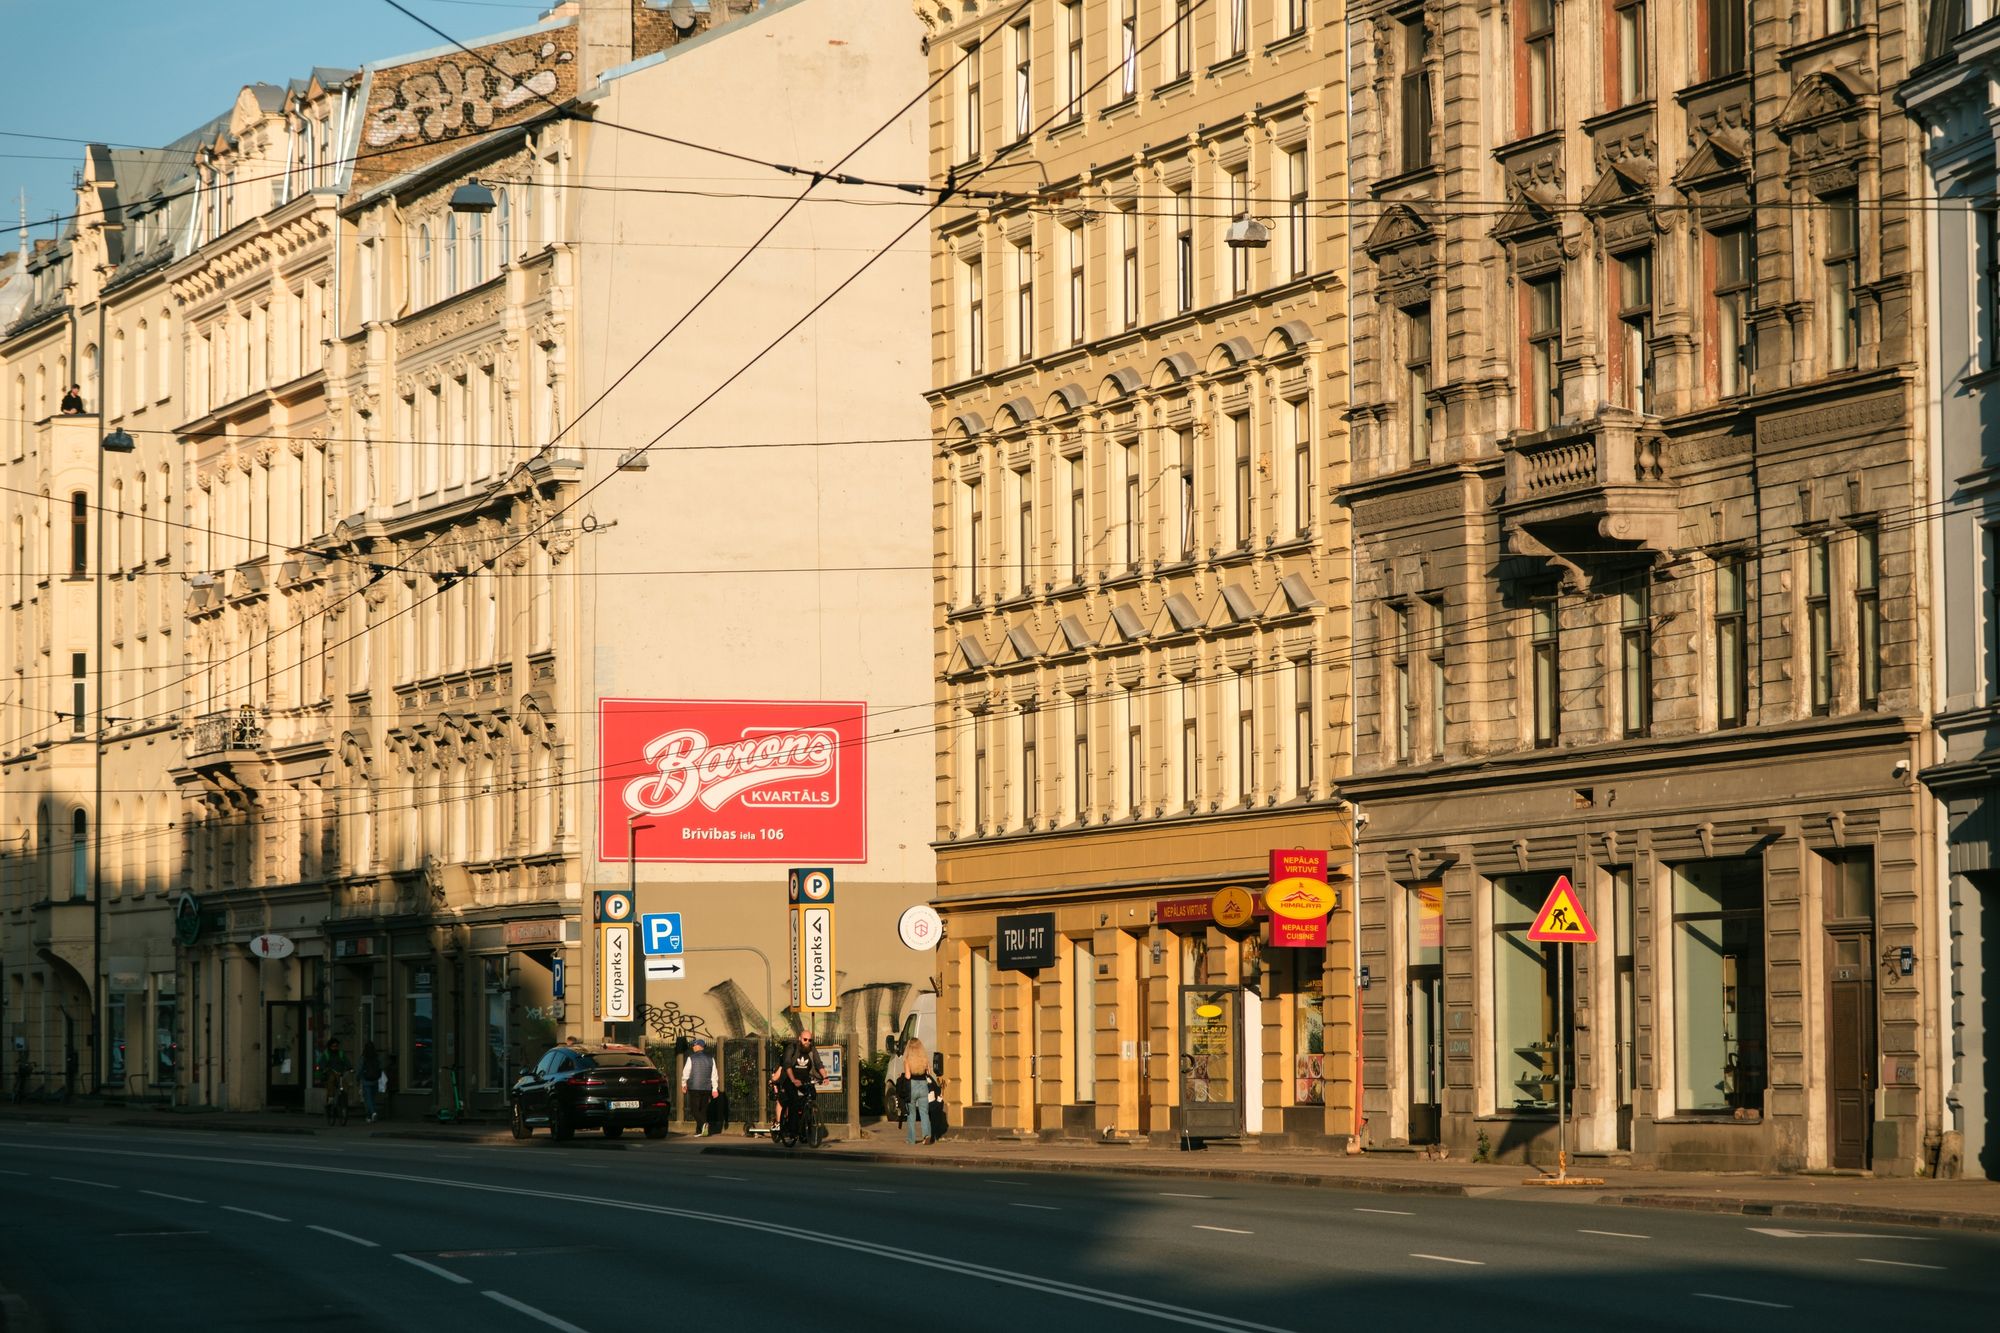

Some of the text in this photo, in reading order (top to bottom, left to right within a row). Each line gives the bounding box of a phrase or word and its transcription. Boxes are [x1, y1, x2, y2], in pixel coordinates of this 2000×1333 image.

[751, 789, 830, 803] KVARTĀLS
[682, 827, 784, 841] Brīvības iela 106
[1283, 855, 1319, 865] NEPĀLAS
[1285, 865, 1318, 874] VIRTUVE
[812, 879, 823, 893] P
[614, 900, 623, 914] P
[1163, 903, 1208, 918] NEPĀLAS VIRTUVE
[651, 918, 673, 950] P
[1282, 924, 1319, 932] NEPALESE
[1004, 927, 1045, 952] TRU FIT
[1286, 932, 1315, 941] CUISINE
[811, 936, 826, 1001] Cityparks
[554, 963, 562, 992] P
[611, 952, 625, 1011] Cityparks
[834, 1054, 839, 1070] P
